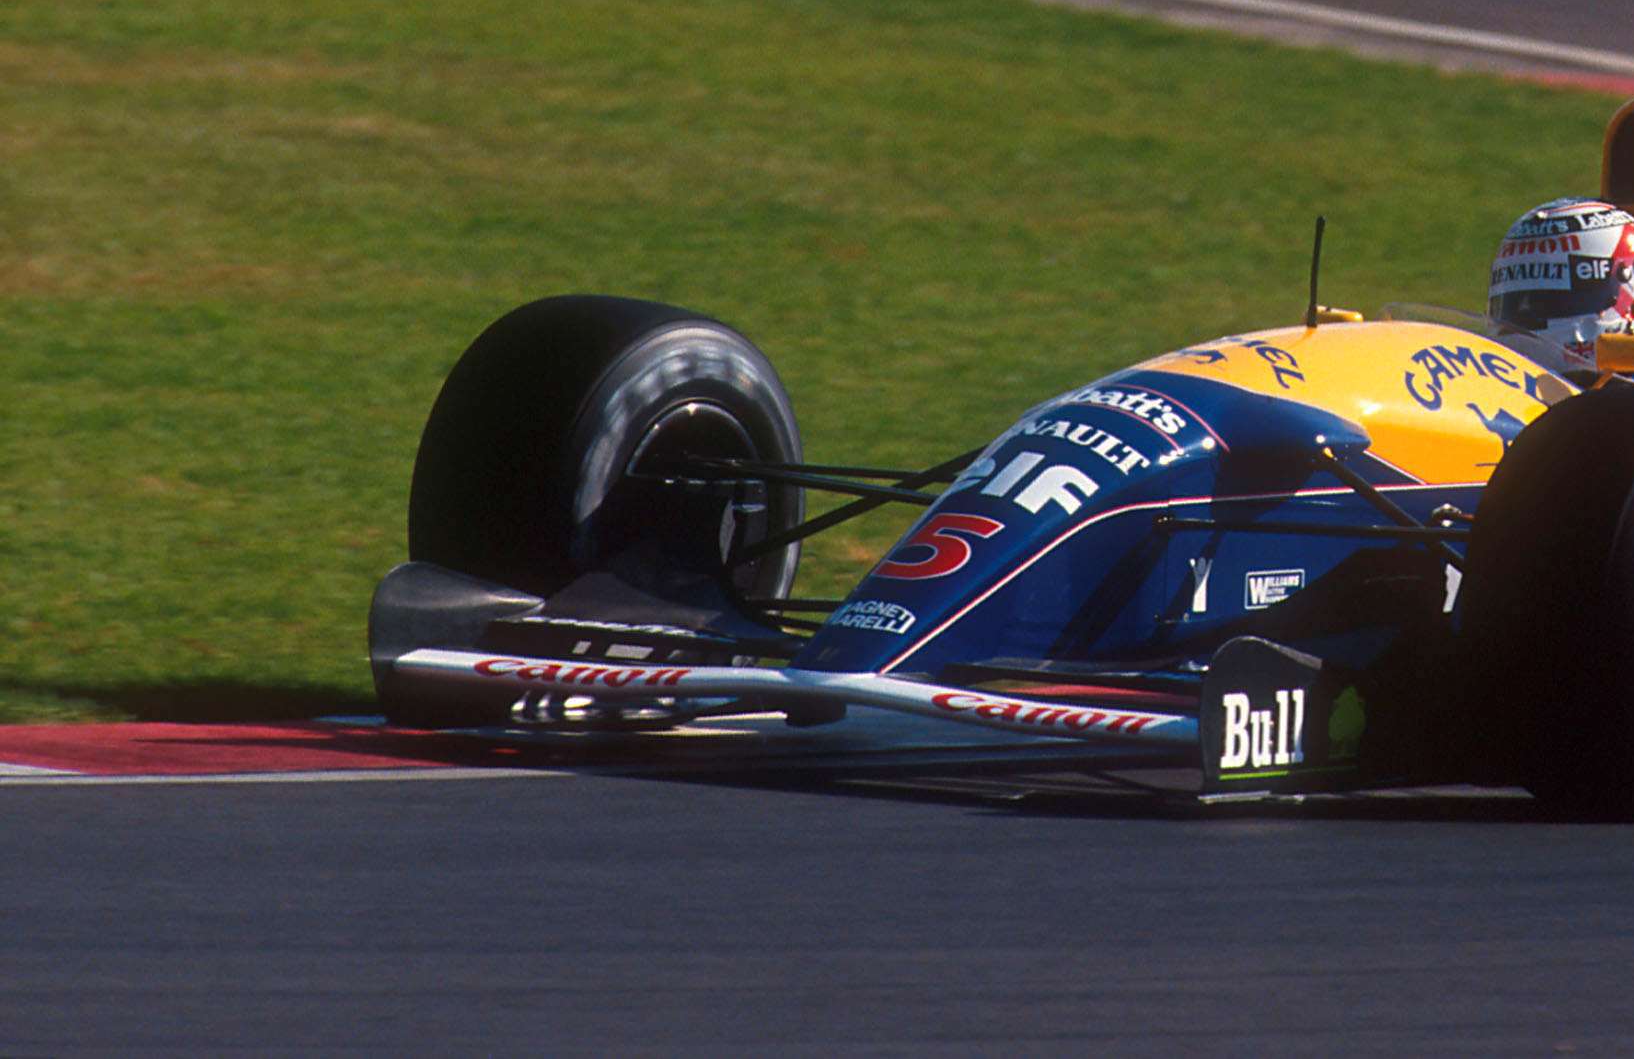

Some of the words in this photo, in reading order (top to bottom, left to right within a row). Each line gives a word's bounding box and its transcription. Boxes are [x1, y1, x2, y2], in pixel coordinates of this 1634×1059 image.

[1501, 234, 1582, 259] anon
[1576, 260, 1611, 281] elf
[1405, 345, 1551, 412] CAMEL
[1070, 389, 1187, 435] batt's
[870, 512, 1006, 581] 5
[474, 659, 691, 688] Canon
[931, 692, 1153, 735] Canon
[1219, 688, 1305, 769] Bull
